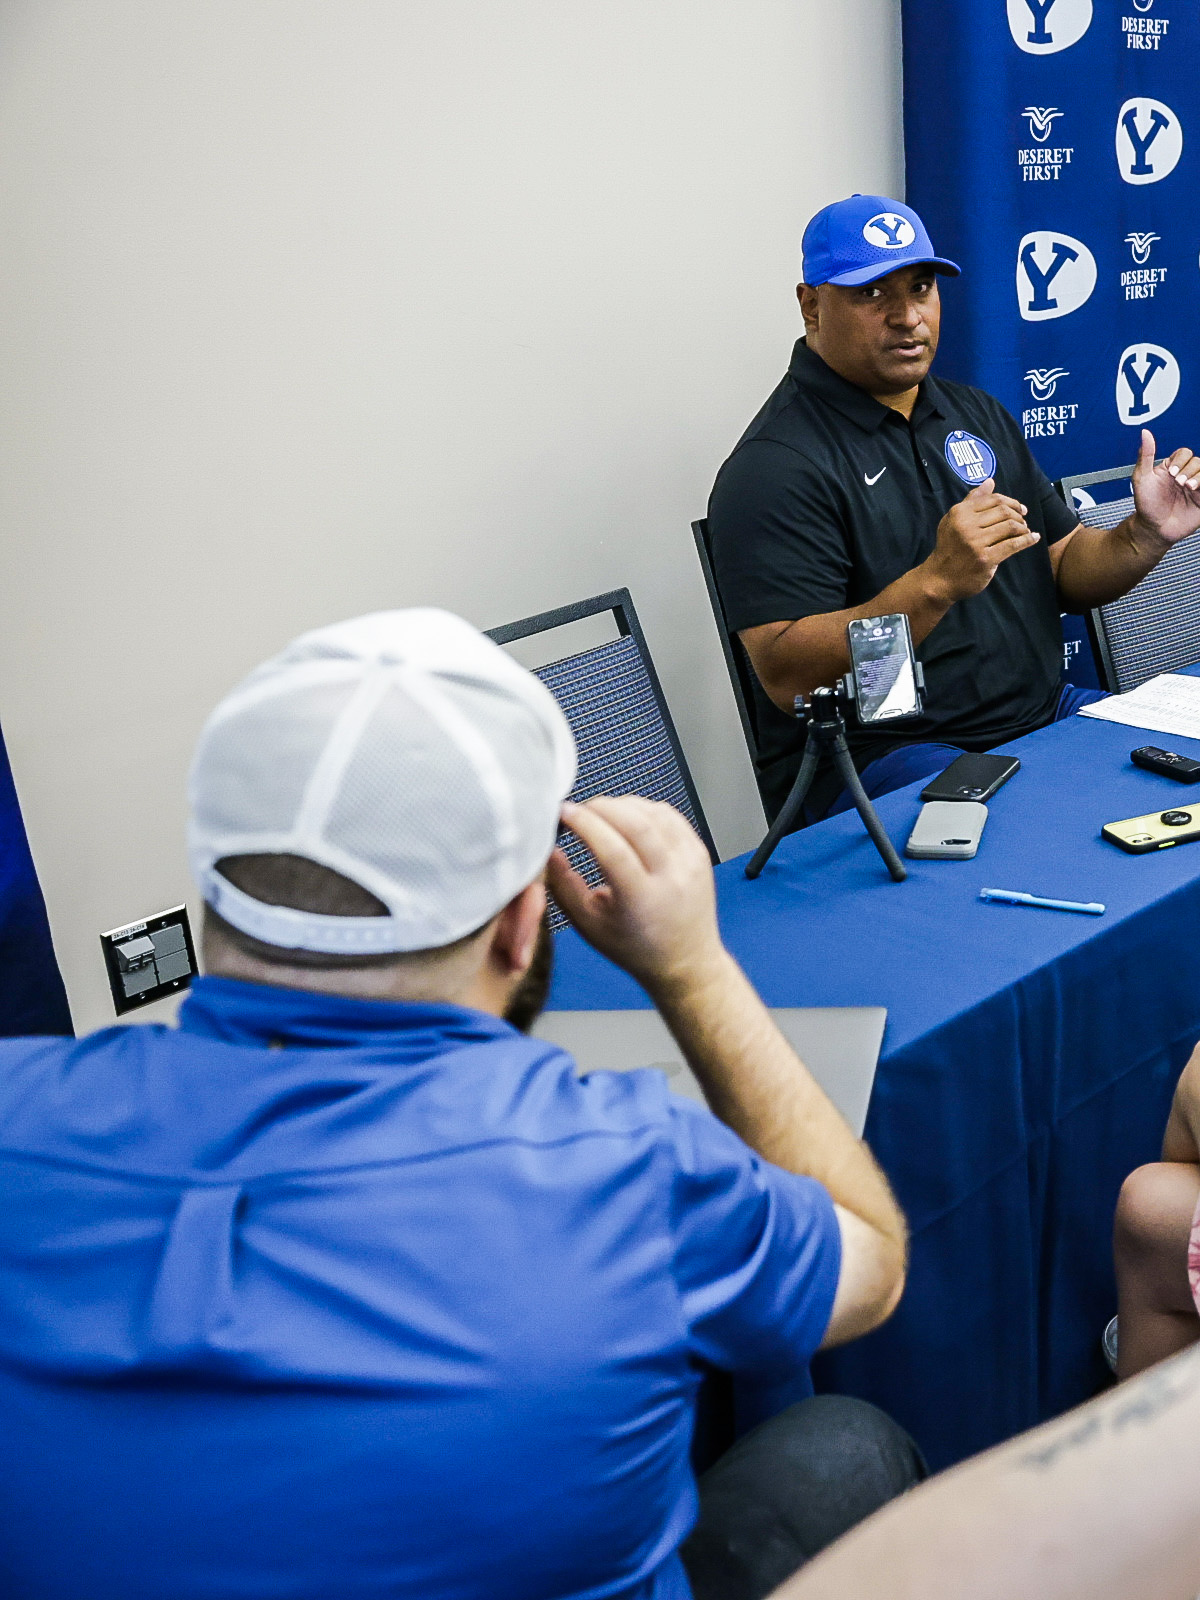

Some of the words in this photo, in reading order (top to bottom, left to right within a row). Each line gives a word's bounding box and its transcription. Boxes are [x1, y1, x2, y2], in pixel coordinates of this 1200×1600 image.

[1122, 17, 1169, 35] DESERET
[1127, 34, 1160, 50] FIRST
[1018, 148, 1074, 165] DESERET
[1023, 164, 1061, 181] FIRST
[869, 217, 905, 245] Y
[1121, 268, 1167, 286] DESERET
[1125, 283, 1157, 300] FIRST
[1024, 421, 1067, 440] FIRST
[949, 439, 984, 467] BUILT
